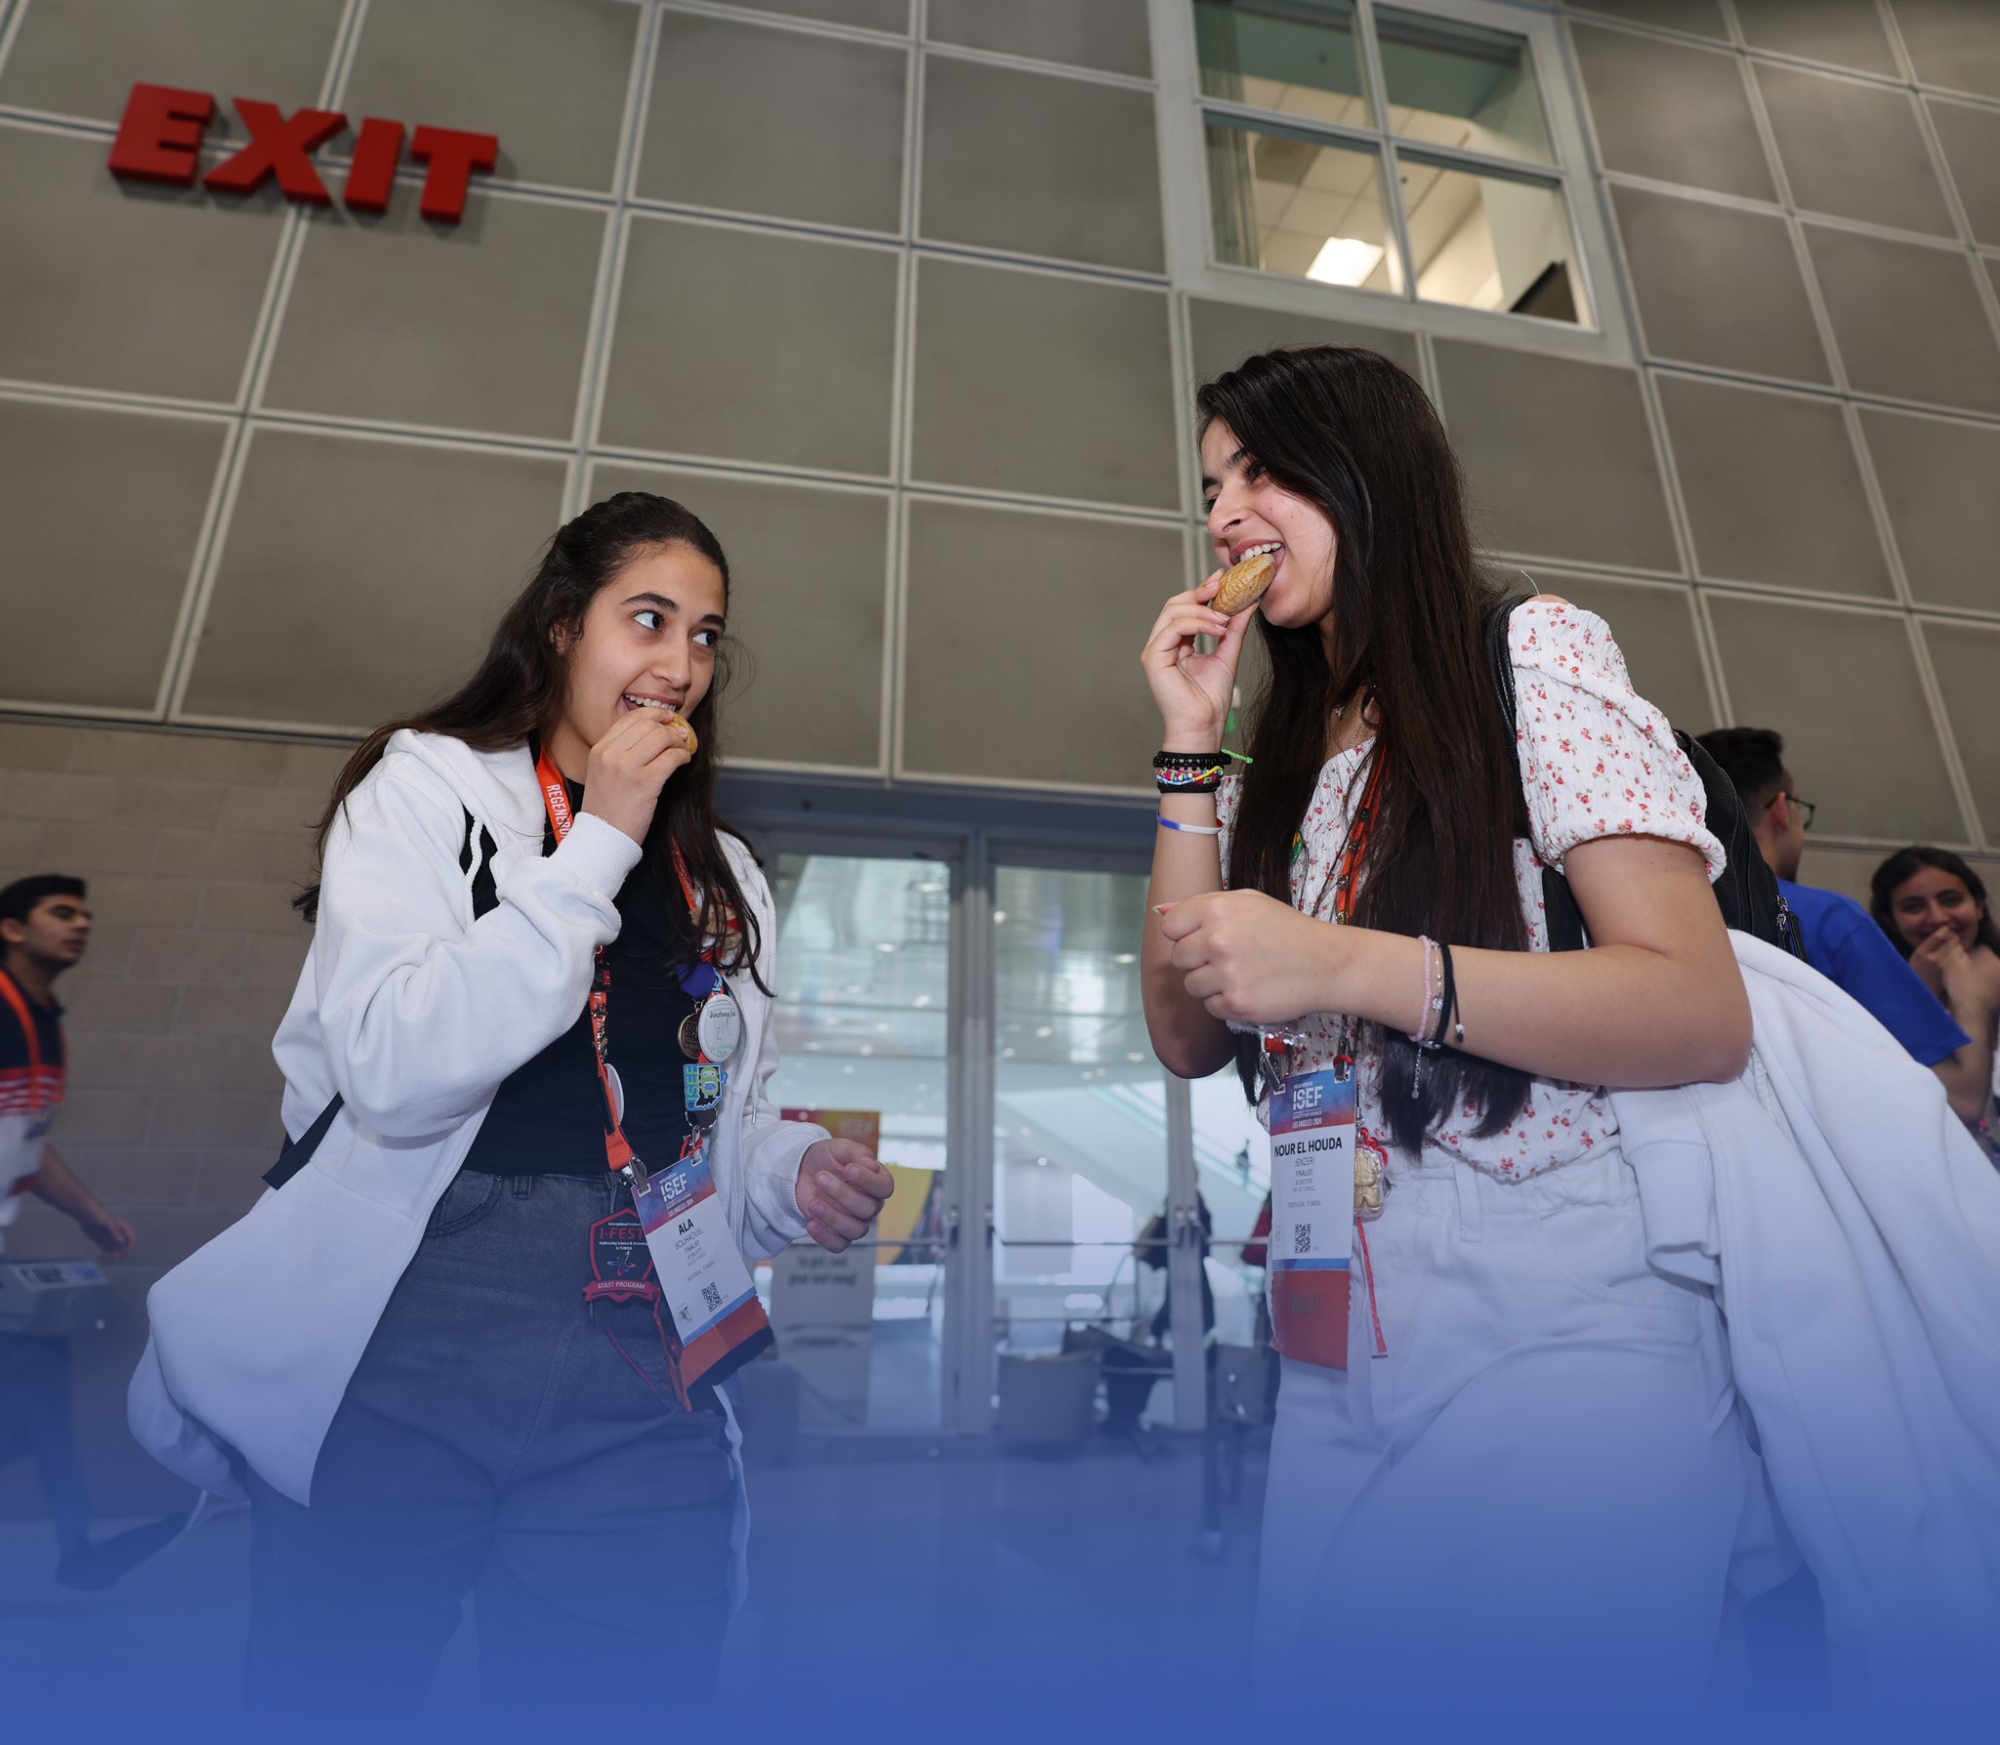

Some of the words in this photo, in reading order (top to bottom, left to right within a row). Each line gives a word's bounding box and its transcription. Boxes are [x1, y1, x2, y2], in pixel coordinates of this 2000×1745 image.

[108, 82, 499, 224] EXIT
[546, 783, 572, 839] REGENERO
[687, 1066, 697, 1100] ISEF
[1292, 1085, 1324, 1111] ISEF
[1274, 1142, 1296, 1158] NOUR
[1297, 1142, 1306, 1153] EL
[1308, 1137, 1343, 1153] HOUDA
[1295, 1168, 1313, 1177] FINALIST
[660, 1172, 688, 1203] ISEF
[600, 1227, 644, 1240] I-FEST
[678, 1218, 694, 1236] ALA
[615, 1281, 646, 1290] PROGRAM
